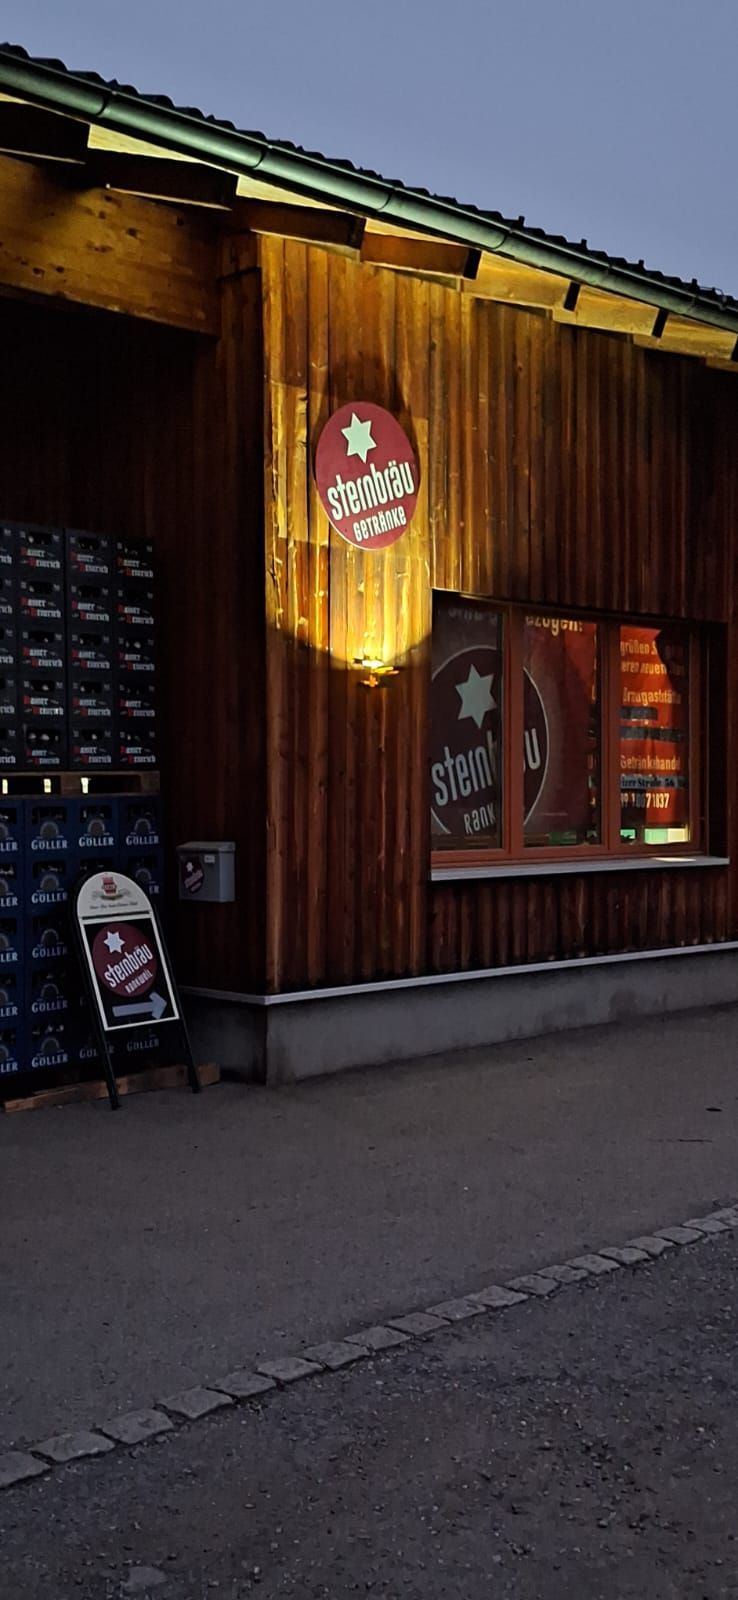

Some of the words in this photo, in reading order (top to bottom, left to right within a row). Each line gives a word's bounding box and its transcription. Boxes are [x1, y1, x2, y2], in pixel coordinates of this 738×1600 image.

[327, 460, 415, 521] sternbräu
[353, 506, 407, 542] GETRÄNKE
[104, 943, 153, 988] sternbräu
